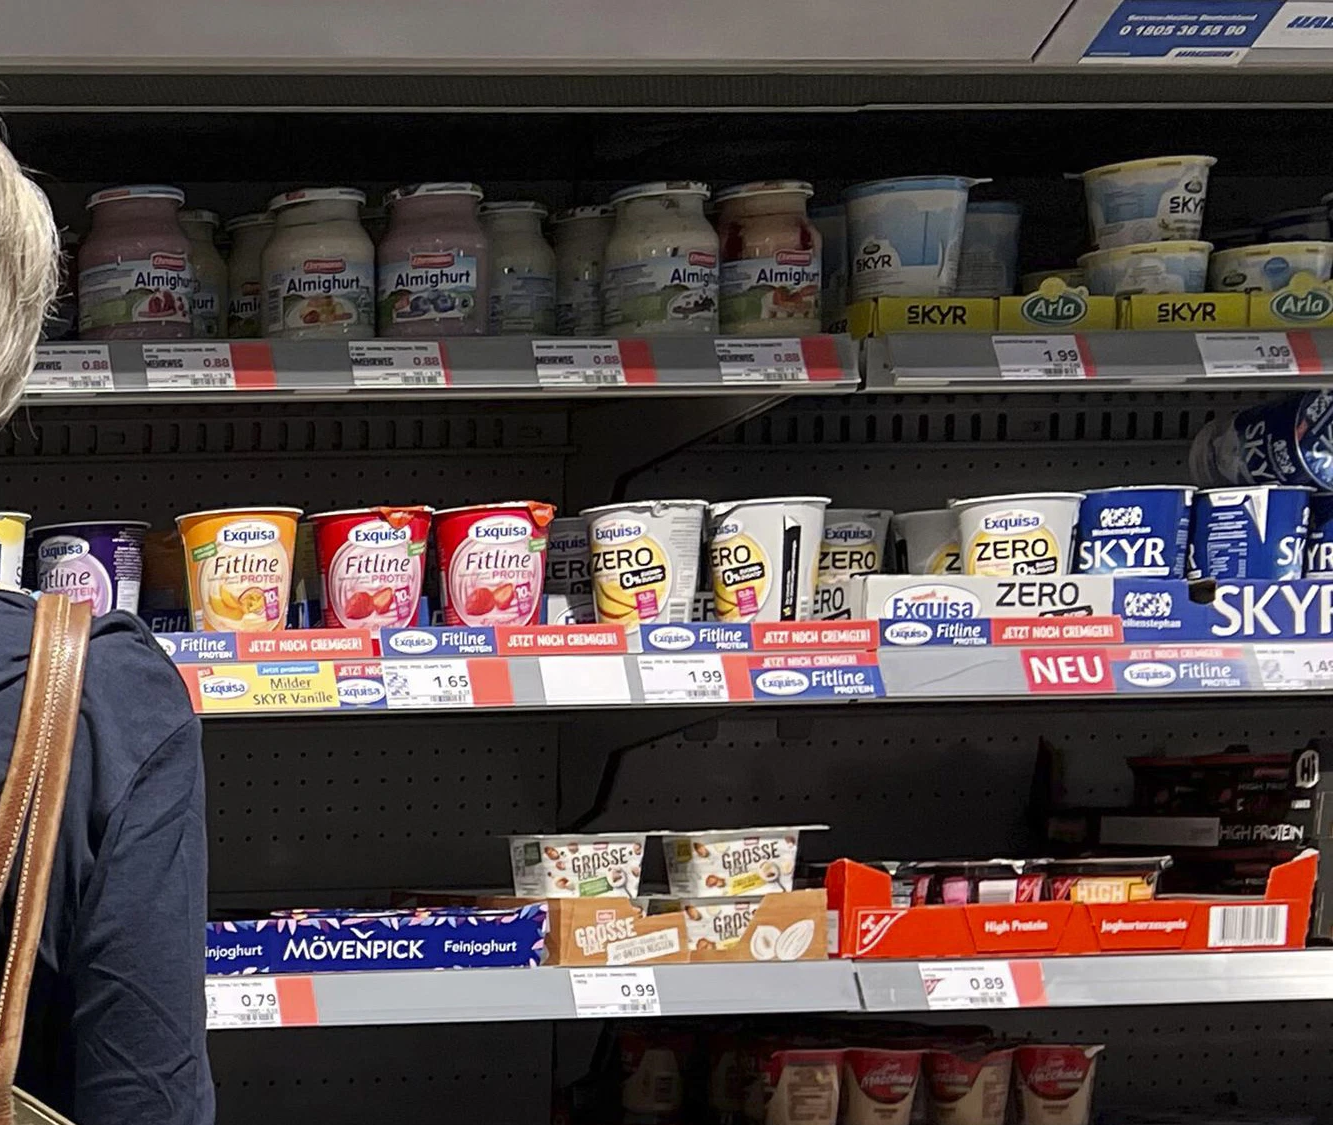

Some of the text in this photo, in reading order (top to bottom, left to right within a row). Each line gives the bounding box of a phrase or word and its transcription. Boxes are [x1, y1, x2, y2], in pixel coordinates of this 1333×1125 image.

[1119, 25, 1131, 36] 0
[1032, 299, 1076, 320] Arla
[1157, 301, 1217, 324] SKYR
[1281, 295, 1325, 316] Arla
[907, 304, 967, 326] SKYR
[1043, 349, 1079, 363] 1.99
[1255, 345, 1291, 359] 1.09
[984, 514, 1040, 530] Exquisa
[221, 527, 276, 545] Exquisa
[354, 528, 407, 545] Exquisa
[475, 525, 528, 541] Exquisa
[976, 539, 1049, 562] ZERO
[1079, 538, 1165, 567] SKYR
[212, 553, 280, 576] Fitline
[344, 555, 411, 575] Fitline
[465, 552, 531, 570] Fitline
[593, 547, 654, 573] ZERO
[996, 583, 1080, 607] ZERO
[1122, 618, 1182, 629] eihenstephan
[441, 632, 486, 647] Fitline
[699, 628, 743, 642] Fitline
[763, 632, 788, 645] JETZT
[1002, 625, 1029, 640] JETZT
[180, 638, 227, 654] Fitline
[248, 638, 363, 653] JETZT NOCH CREMIGER!
[507, 634, 535, 648] JETZT
[198, 652, 233, 660] PROTEIN
[687, 671, 723, 684] 1.99
[1030, 656, 1103, 685] NEU
[270, 677, 312, 690] Milder
[433, 675, 469, 689] 1.65
[811, 670, 865, 687] Fitline
[202, 681, 247, 695] Exquisa
[337, 685, 381, 699] Exquisa
[252, 691, 333, 706] SKYR Vanille
[571, 846, 628, 874] GROSSE
[721, 842, 780, 870] GROSSE
[574, 917, 637, 949] GROSSE
[985, 919, 1049, 933] High Protein
[283, 935, 425, 961] MÖVENPICK
[444, 940, 518, 955] Feinjoghurt
[620, 984, 656, 998] 0.99
[969, 977, 1005, 990] 0.89
[241, 994, 277, 1008] 0.79
